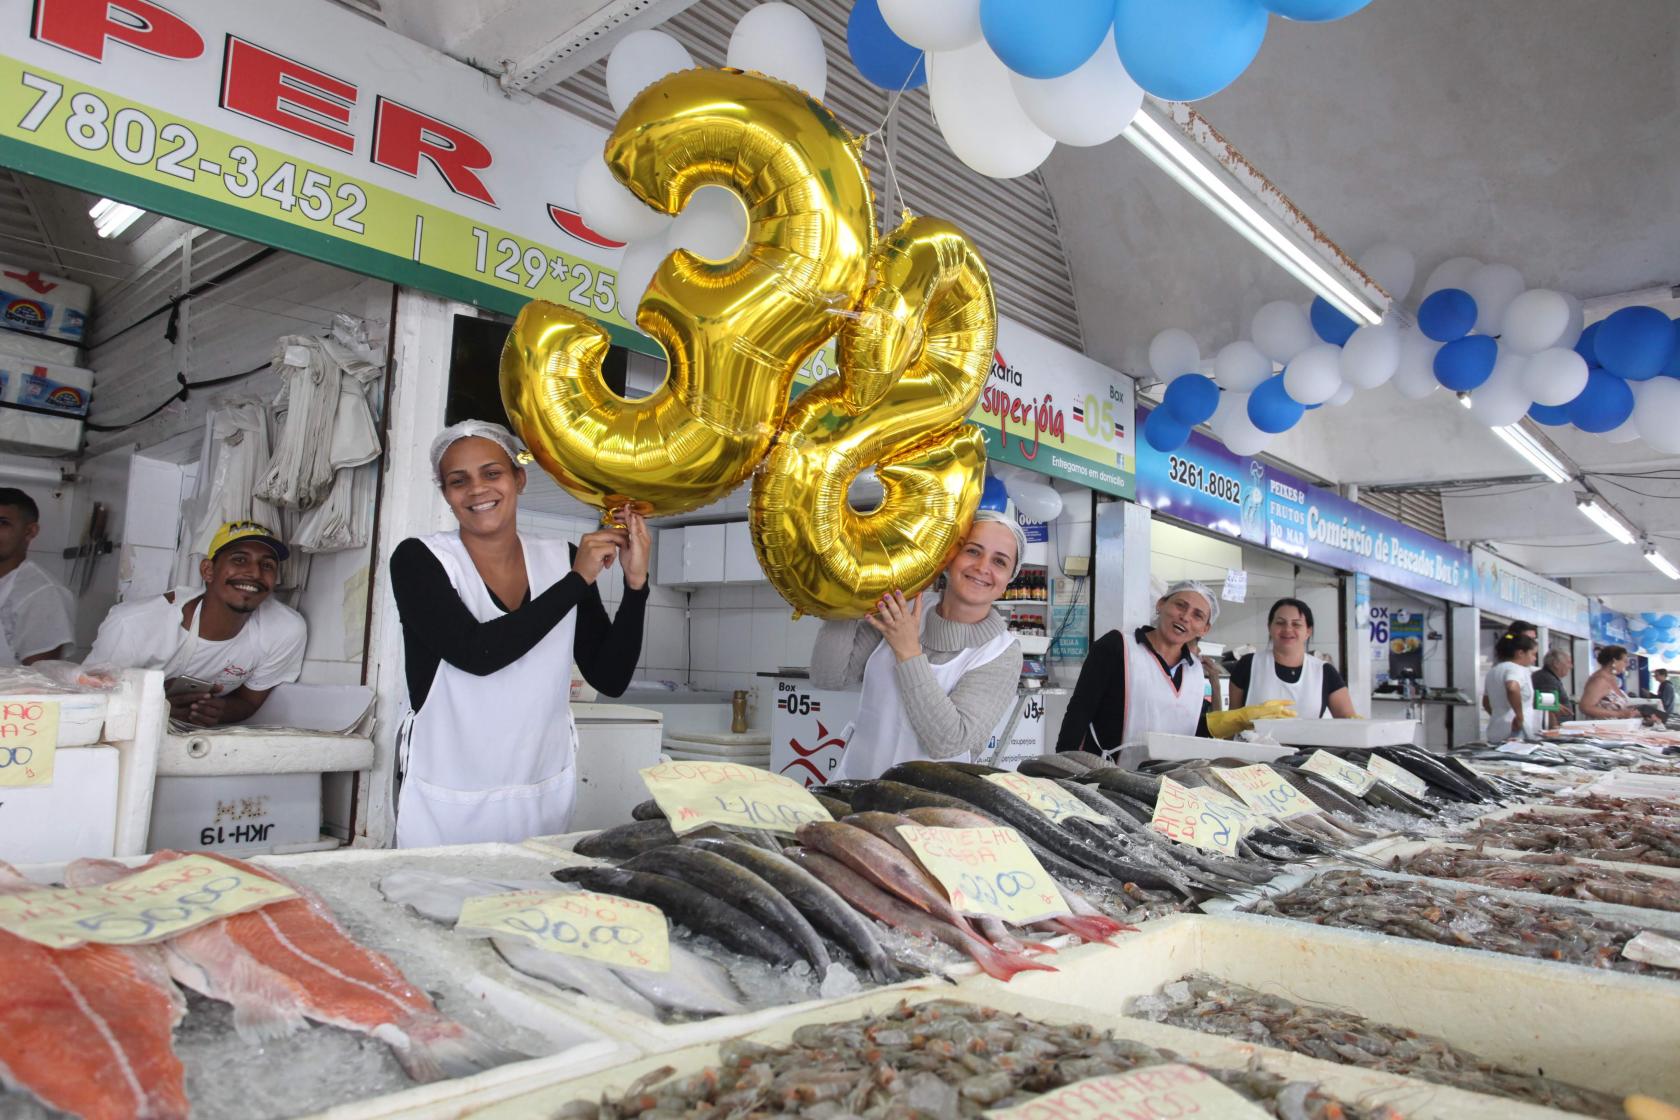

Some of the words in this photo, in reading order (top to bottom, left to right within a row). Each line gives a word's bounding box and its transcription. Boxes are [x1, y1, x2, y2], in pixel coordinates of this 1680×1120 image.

[17, 71, 367, 235] 7802-3452
[1109, 384, 1124, 403] Box
[1083, 393, 1116, 443] 05
[1052, 455, 1088, 476] Entregamos
[1168, 456, 1241, 505] 3261.8082
[1270, 480, 1298, 501] PEIXES
[1270, 501, 1305, 525] FRUTOS
[1286, 530, 1305, 545] MAR
[1307, 506, 1373, 557] Comércio
[1375, 532, 1389, 563] de
[778, 682, 796, 692] Box
[200, 823, 275, 846] JKH-19
